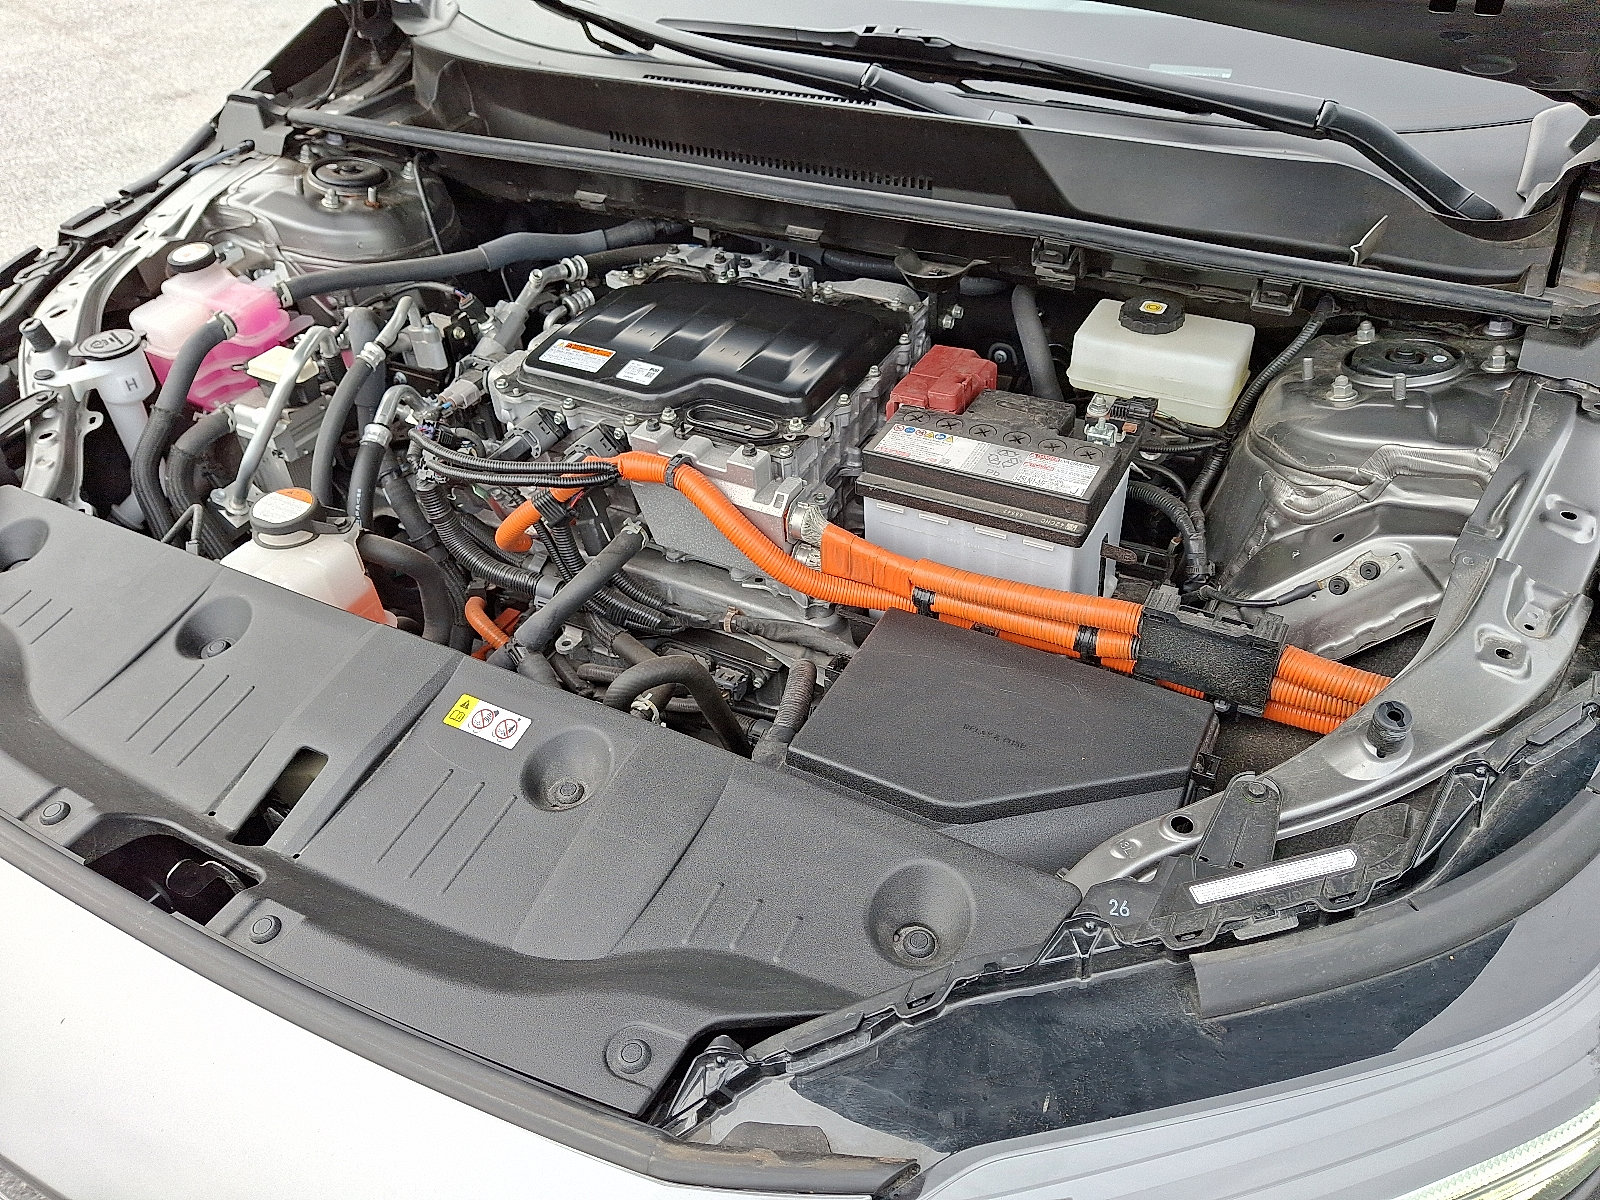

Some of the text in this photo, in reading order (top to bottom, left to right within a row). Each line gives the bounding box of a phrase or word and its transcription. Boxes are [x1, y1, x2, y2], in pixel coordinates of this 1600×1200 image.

[125, 377, 139, 391] H
[985, 468, 1001, 477] Pb
[1108, 898, 1130, 917] 26
